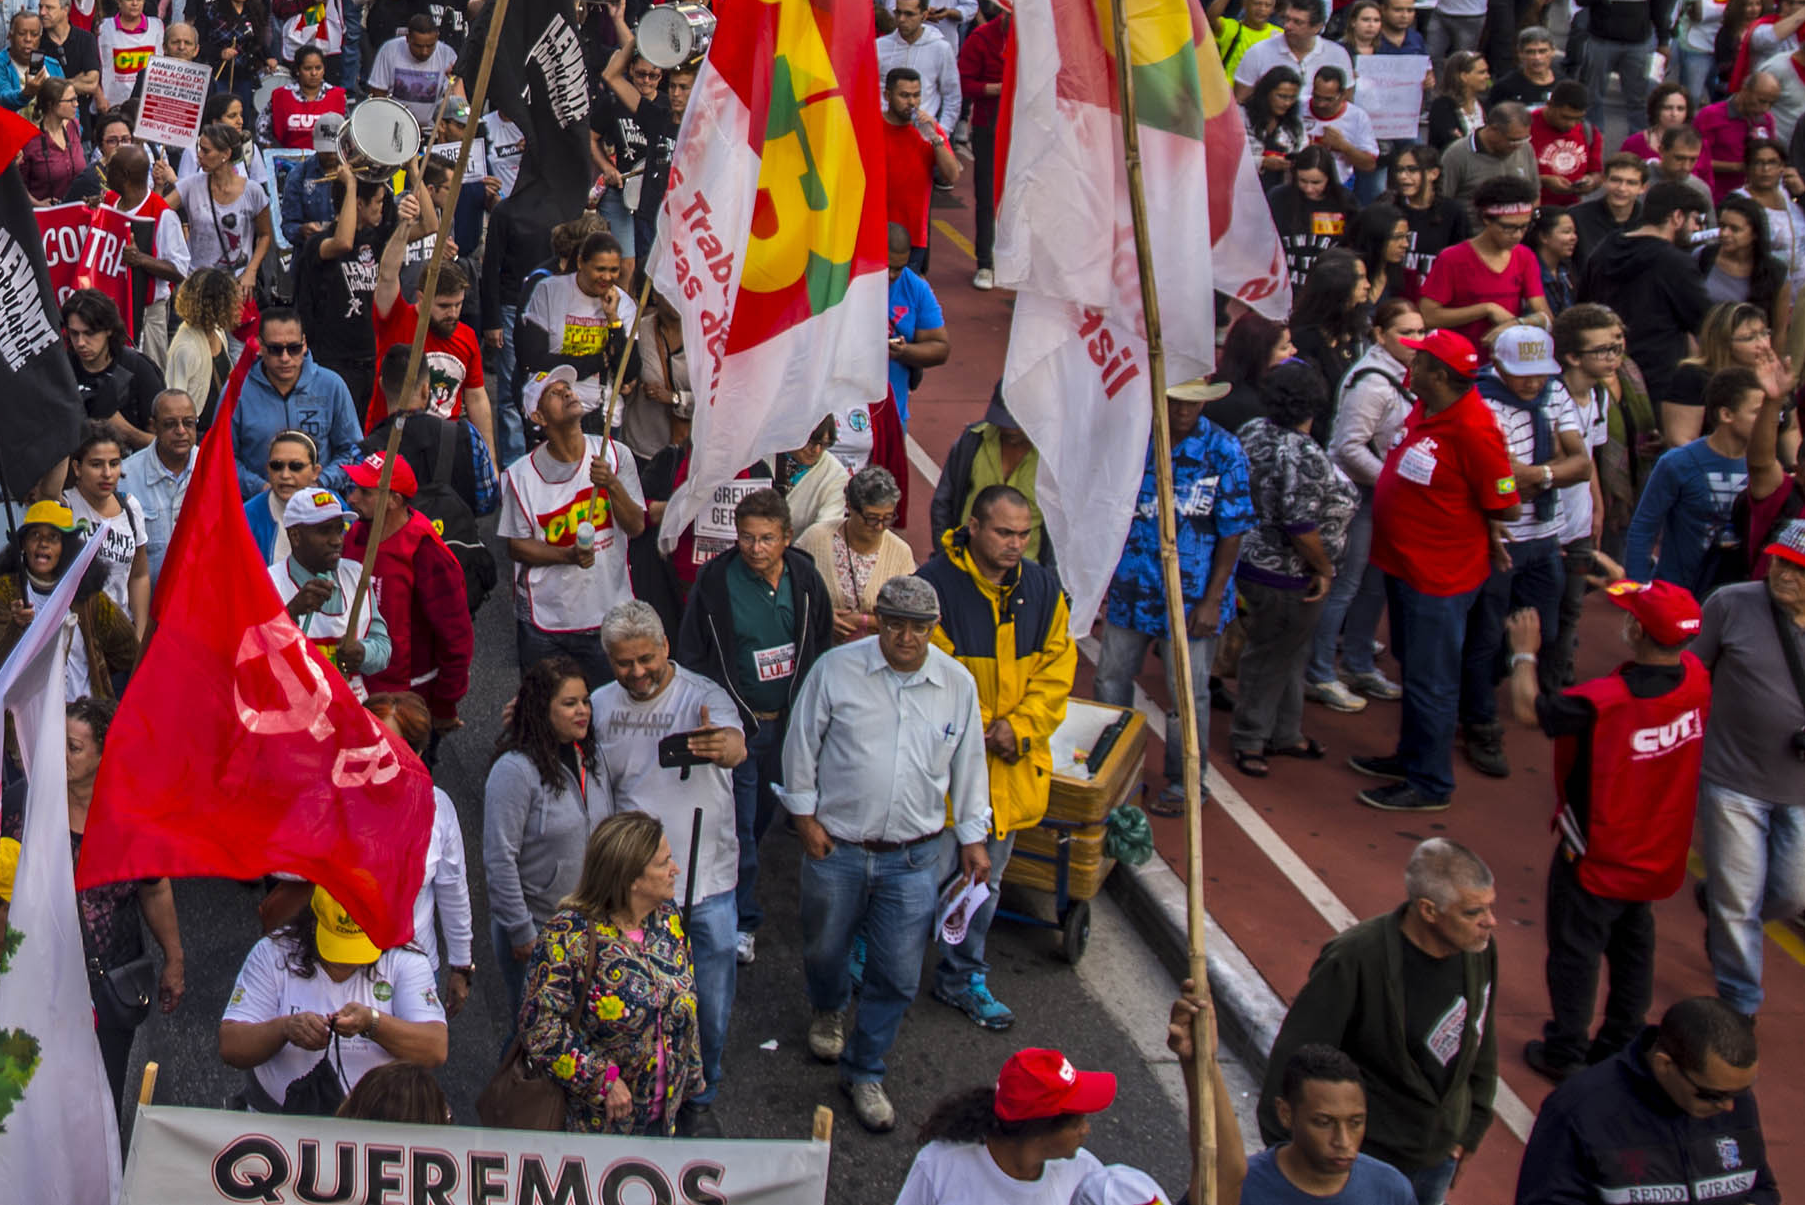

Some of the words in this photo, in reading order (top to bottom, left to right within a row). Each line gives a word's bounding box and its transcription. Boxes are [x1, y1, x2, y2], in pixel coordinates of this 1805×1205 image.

[141, 120, 166, 131] GREVE
[714, 486, 755, 505] GREV
[1631, 711, 1693, 749] CUT
[212, 1131, 727, 1205] QUEREMOS
